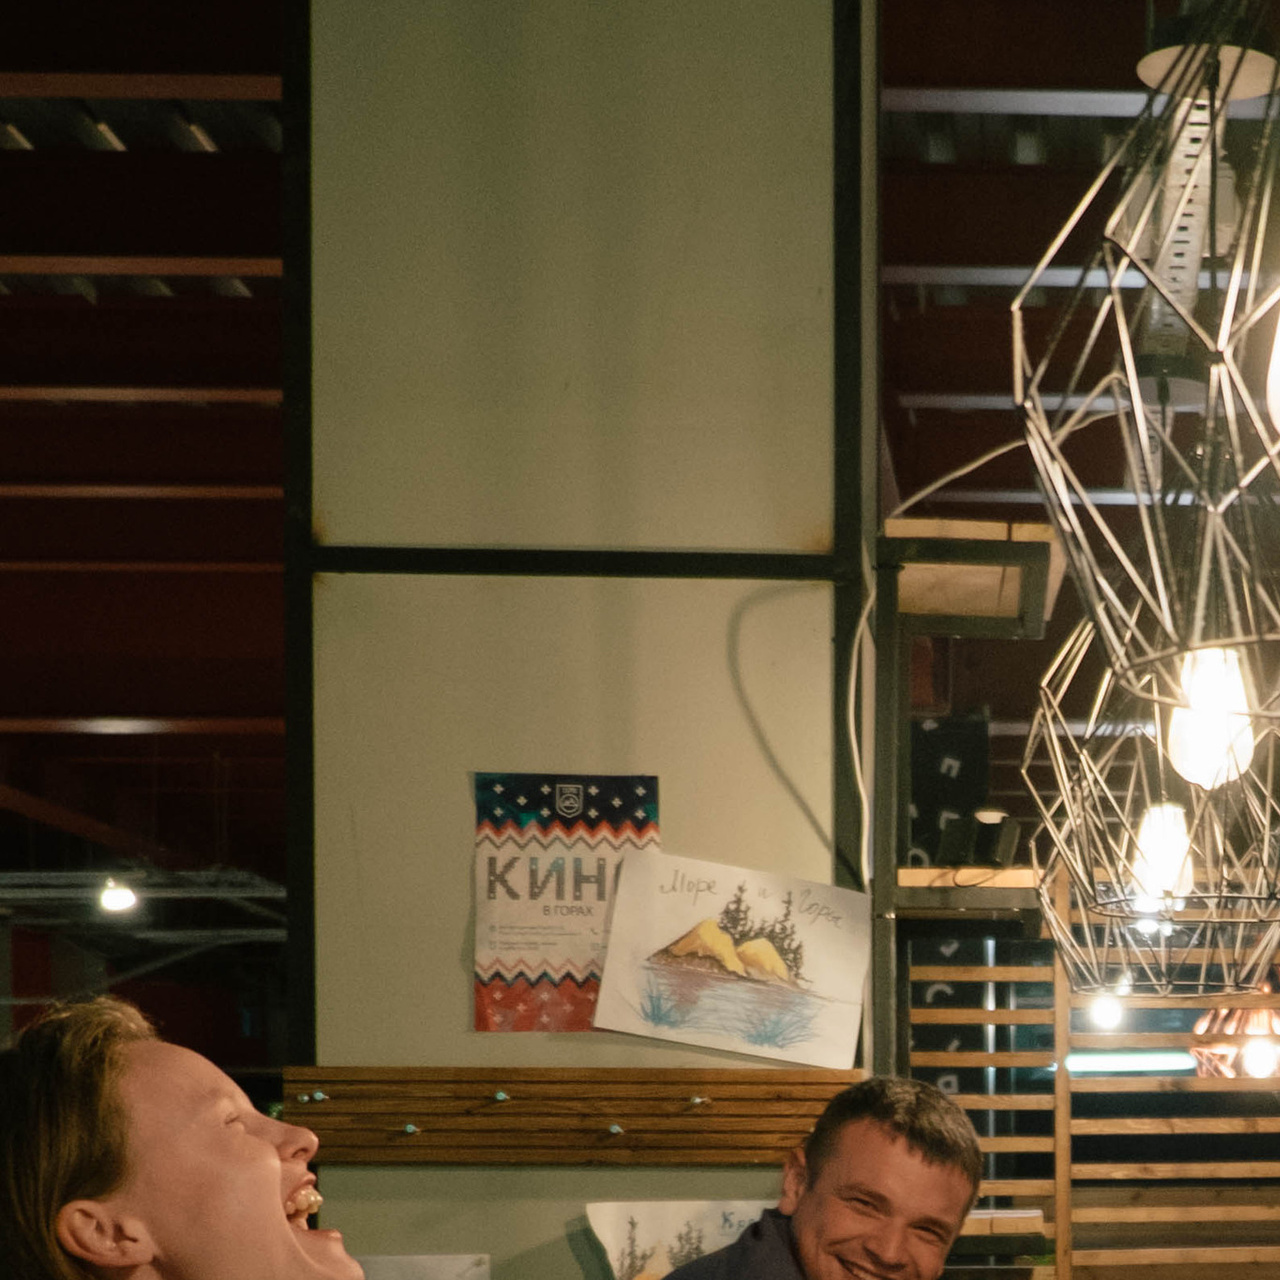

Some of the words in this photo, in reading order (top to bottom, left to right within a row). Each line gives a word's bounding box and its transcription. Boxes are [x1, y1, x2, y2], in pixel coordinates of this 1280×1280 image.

[487, 857, 623, 900] КИН
[660, 869, 717, 906] Море
[543, 905, 551, 916] В
[554, 905, 595, 917] ГОРАХ
